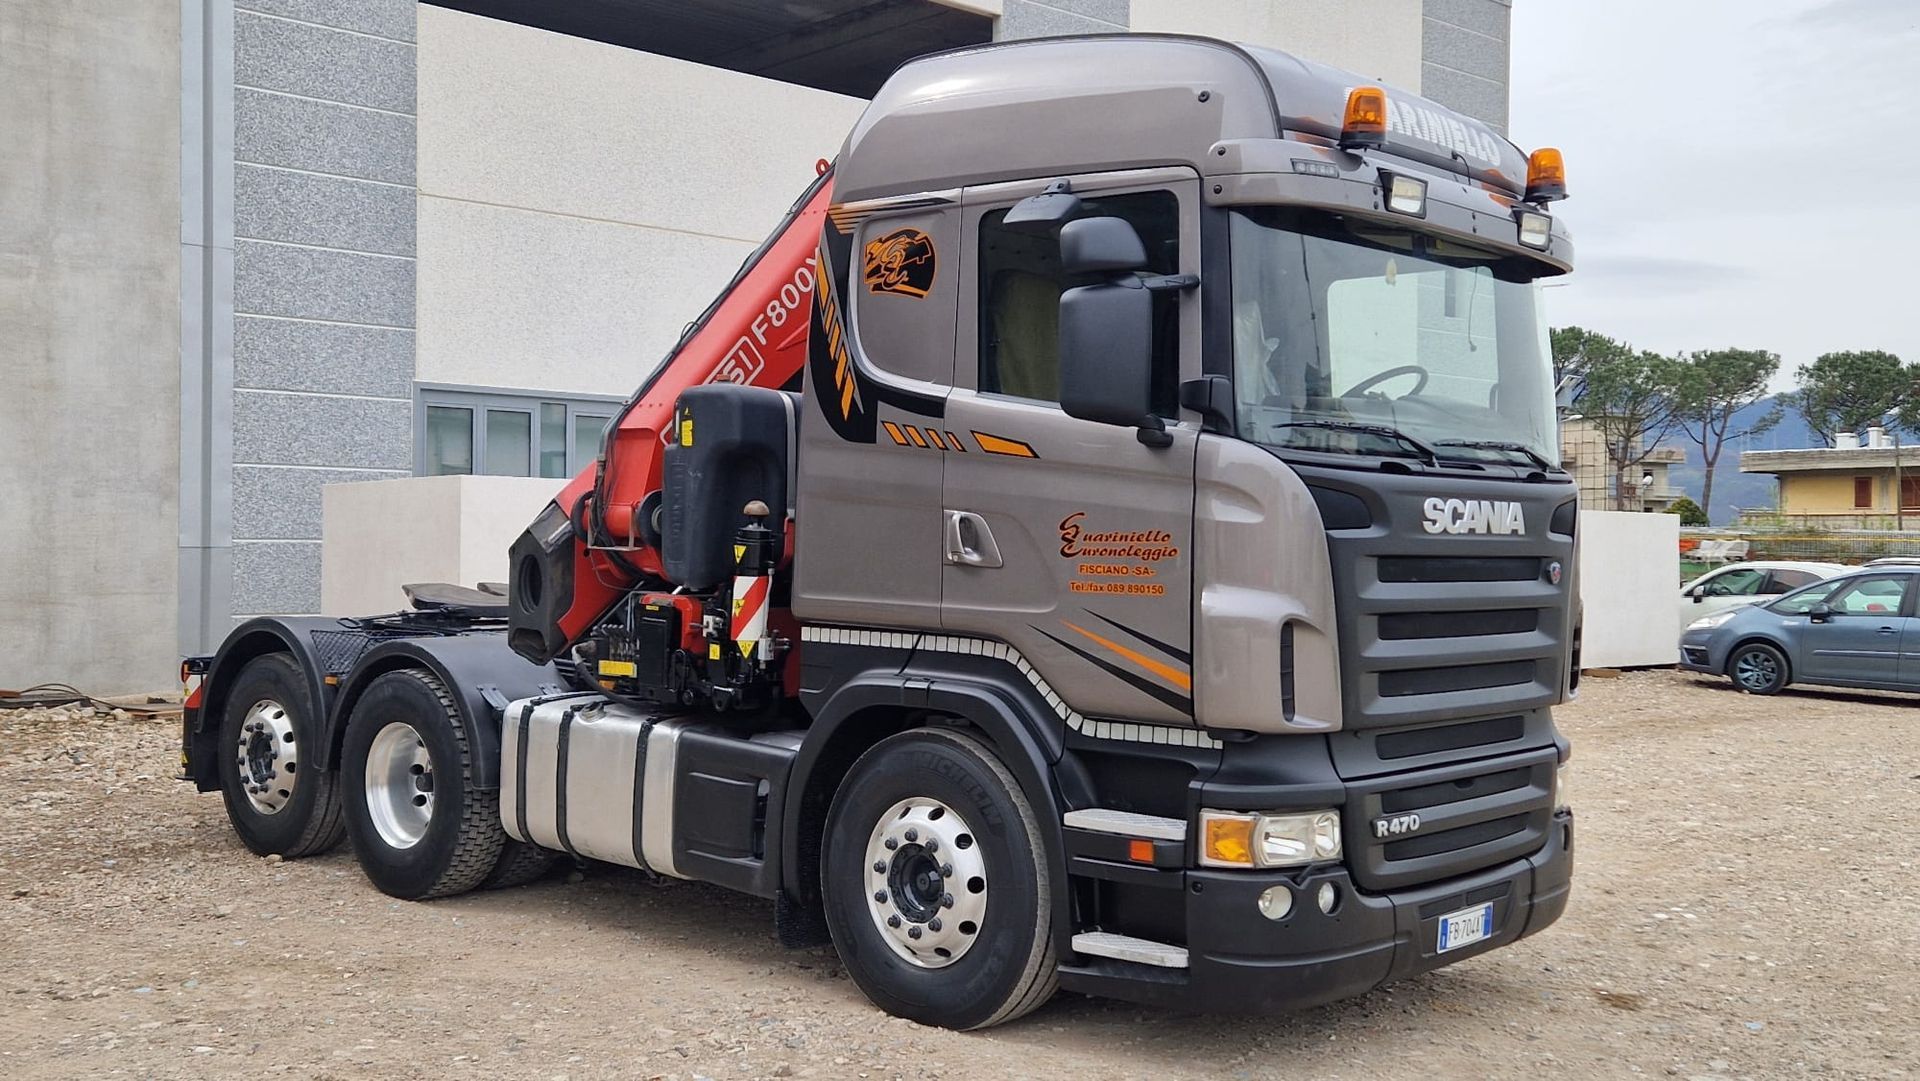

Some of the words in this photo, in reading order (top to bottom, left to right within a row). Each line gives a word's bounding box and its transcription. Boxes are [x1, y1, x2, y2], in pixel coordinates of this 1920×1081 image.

[1422, 497, 1526, 535] SCANIA
[1079, 564, 1129, 575] FISCIANO
[1106, 583, 1125, 593] 089
[1127, 584, 1164, 594] 890150
[1376, 815, 1420, 838] R470
